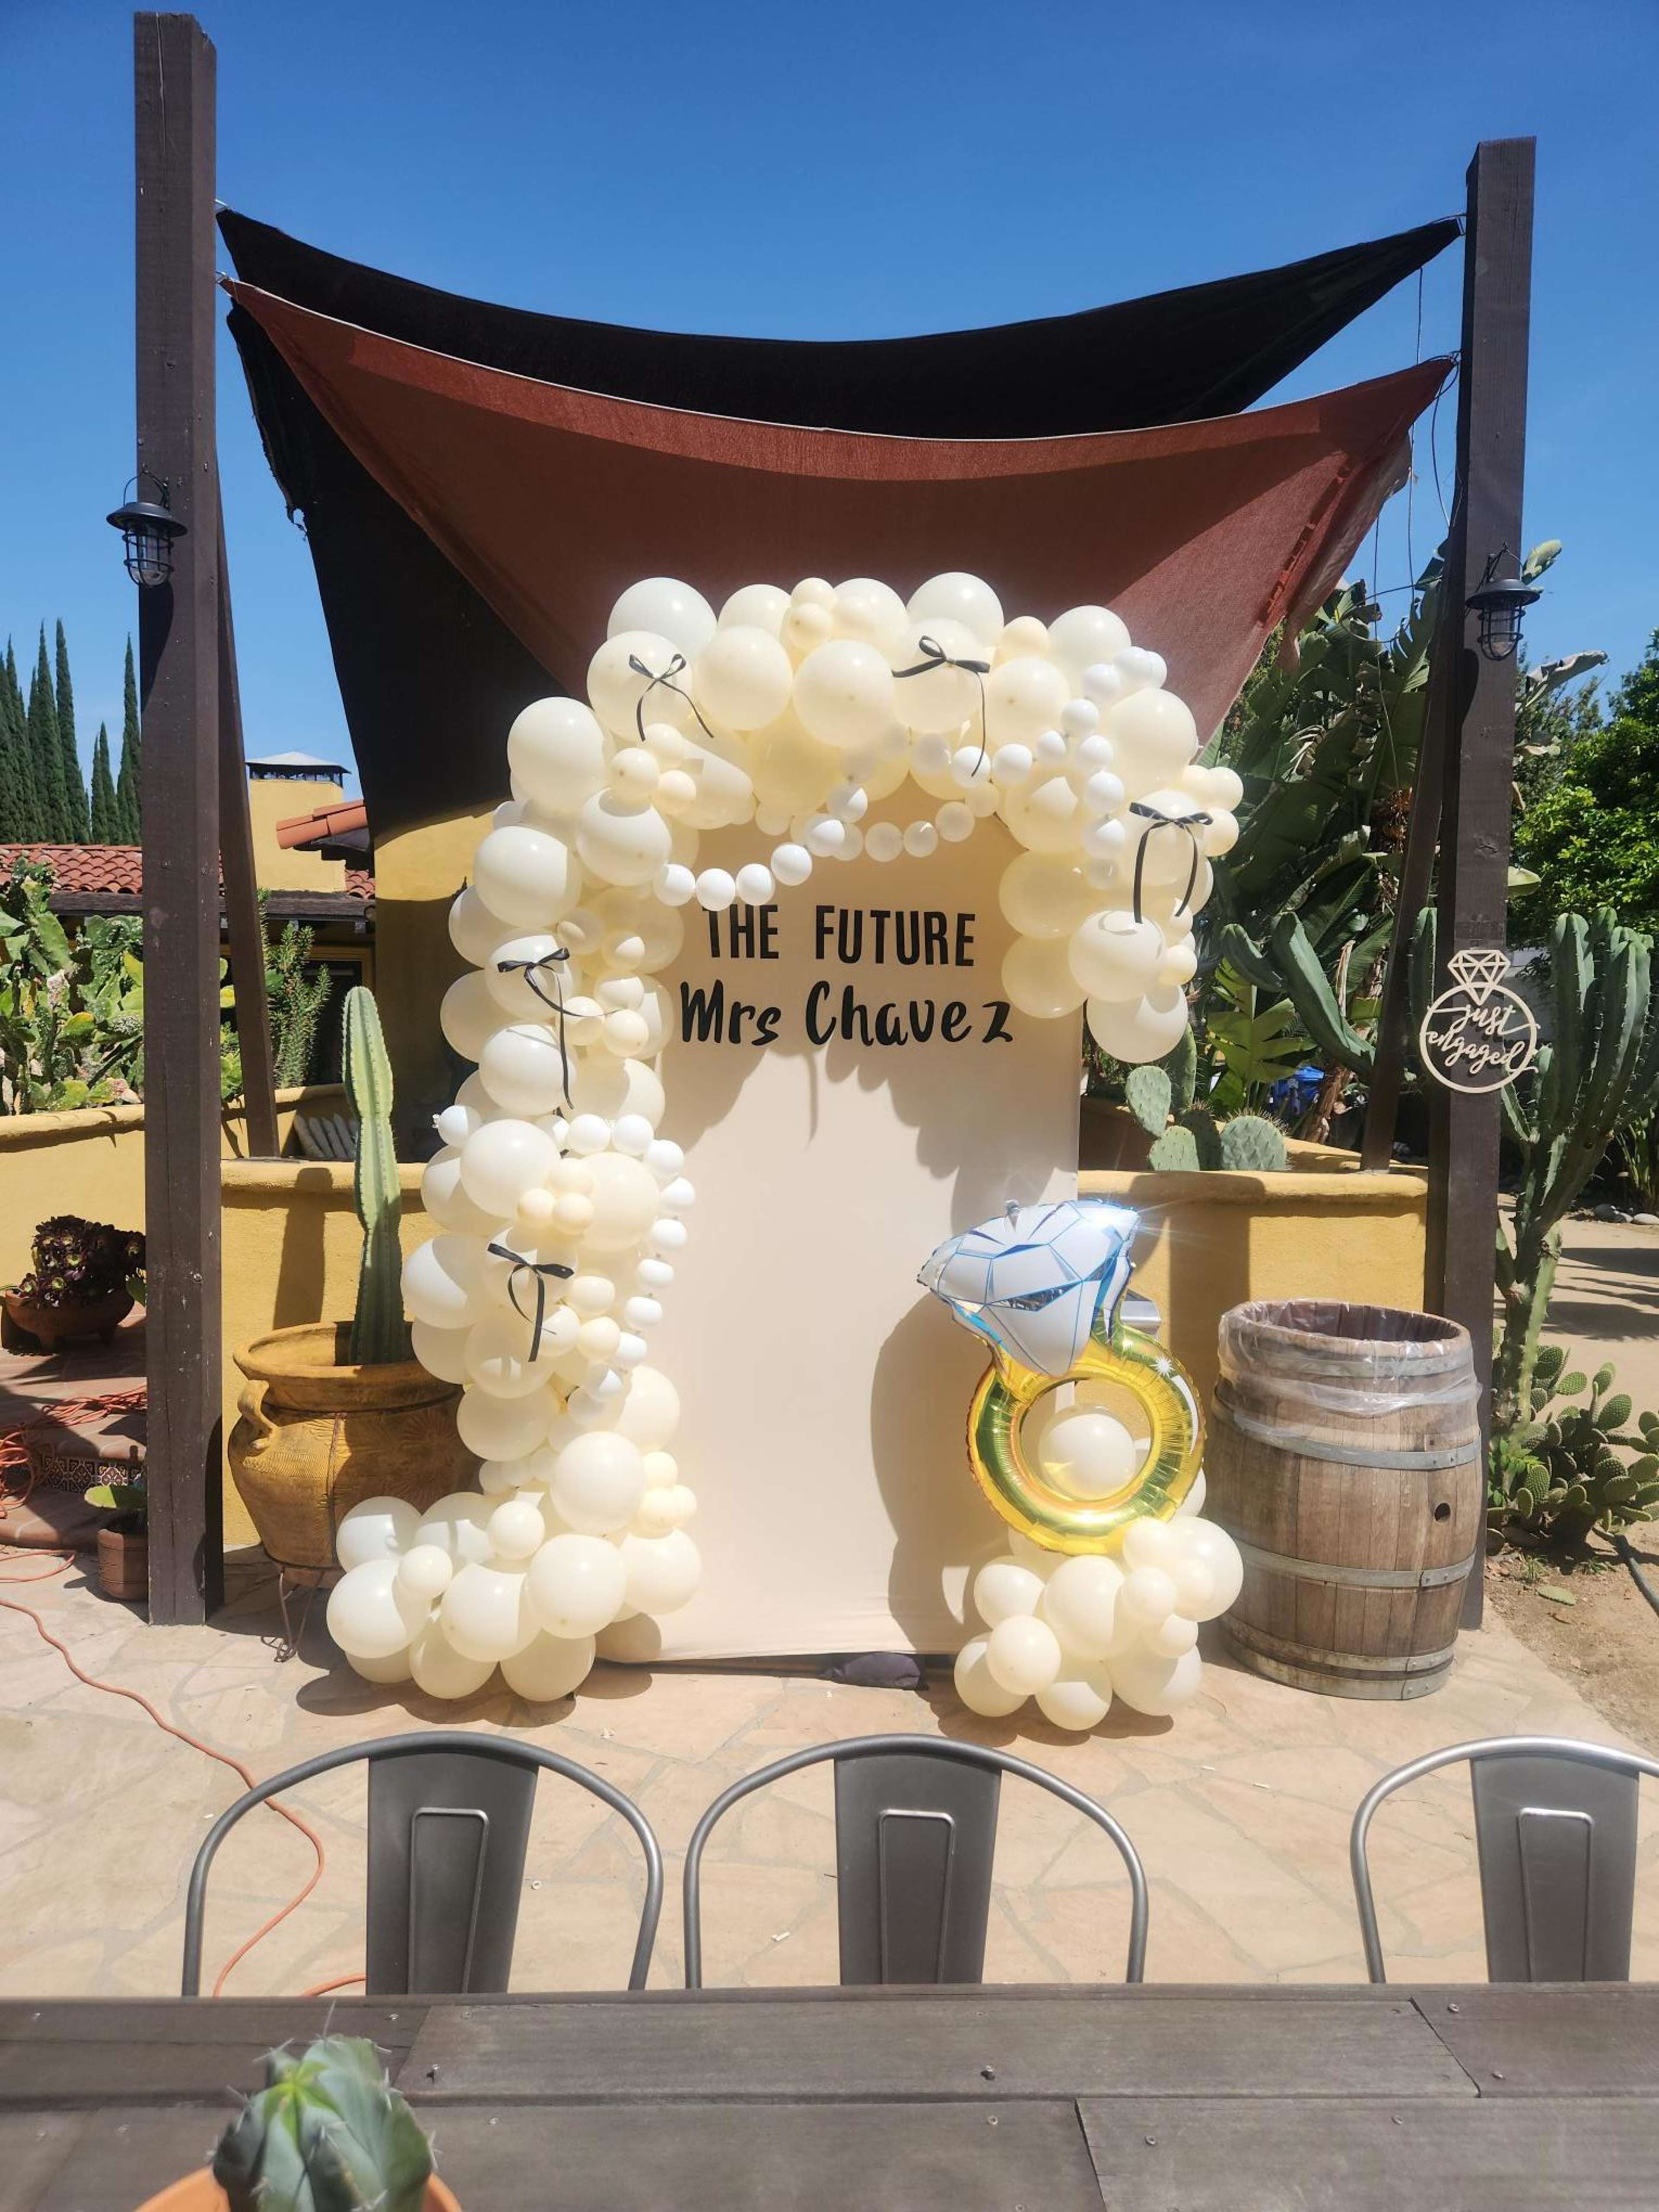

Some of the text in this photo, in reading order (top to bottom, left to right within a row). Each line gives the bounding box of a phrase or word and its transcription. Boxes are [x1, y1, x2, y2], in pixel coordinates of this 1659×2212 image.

[702, 903, 976, 966] THE FUTURE
[680, 979, 1013, 1046] Mrs Chavez
[1427, 1004, 1541, 1035] just
[1426, 1031, 1539, 1074] engaged
